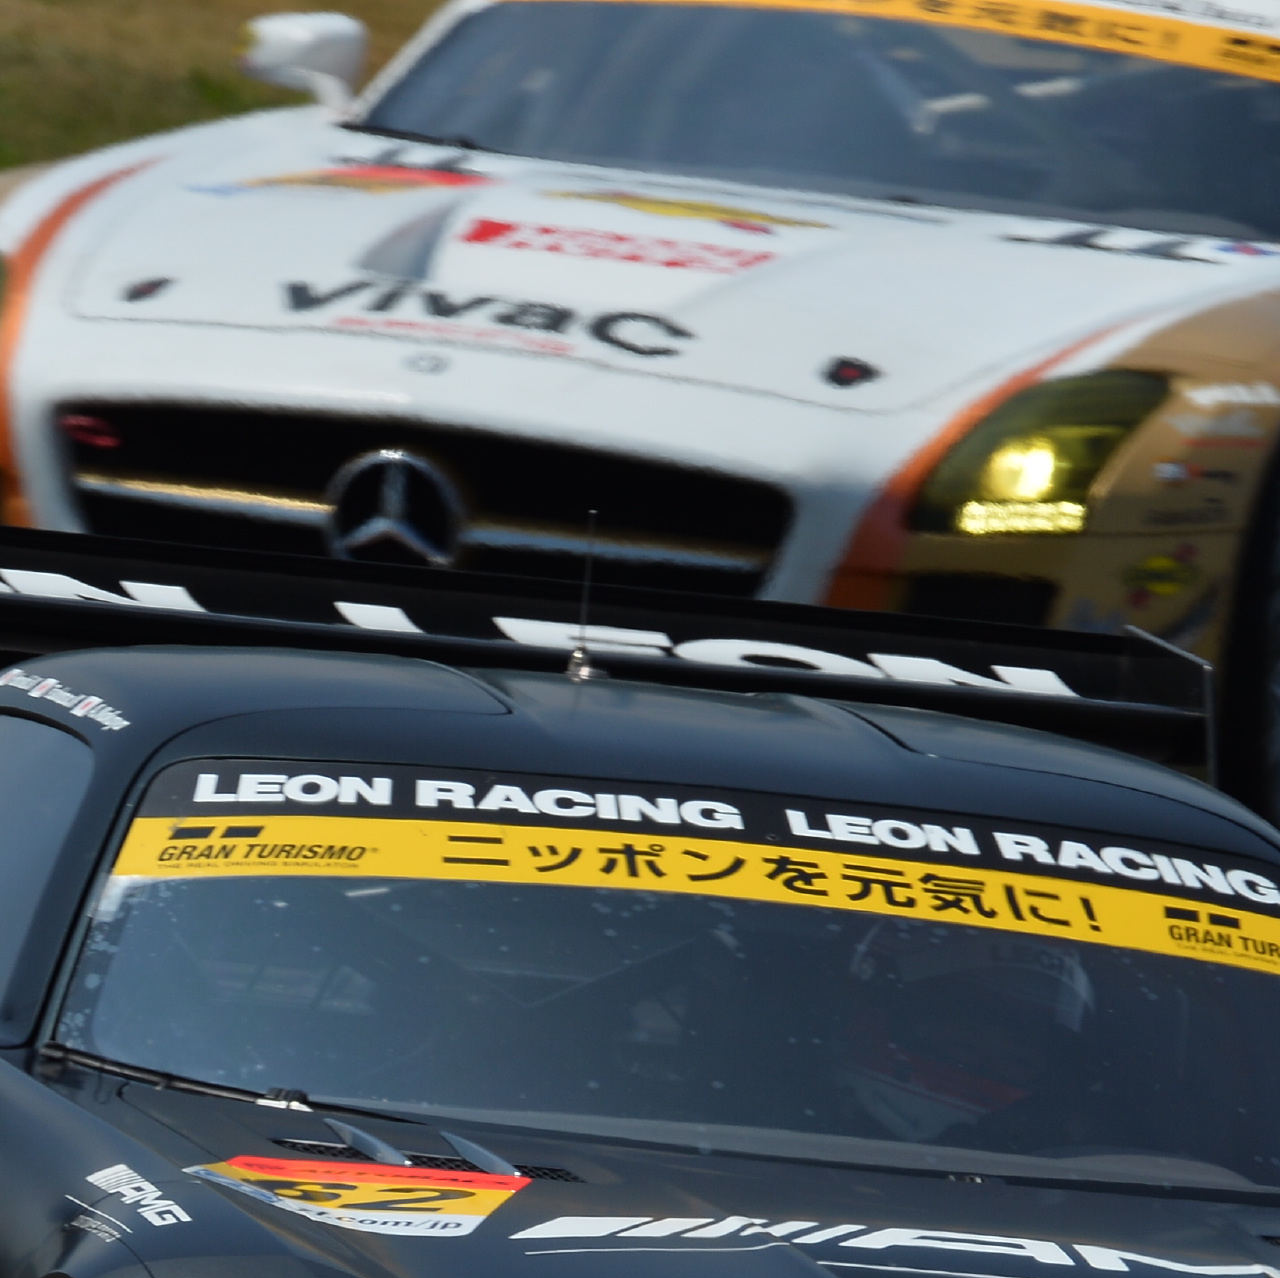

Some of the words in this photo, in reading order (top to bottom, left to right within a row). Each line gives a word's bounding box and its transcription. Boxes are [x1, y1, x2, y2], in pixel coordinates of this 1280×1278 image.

[192, 773, 392, 806] LEON
[415, 779, 744, 830] RACING
[785, 809, 980, 856] LEON
[157, 844, 236, 861] GRAN
[242, 843, 367, 861] TURISMO
[1169, 924, 1233, 949] GRAN
[112, 1178, 193, 1227] AMG
